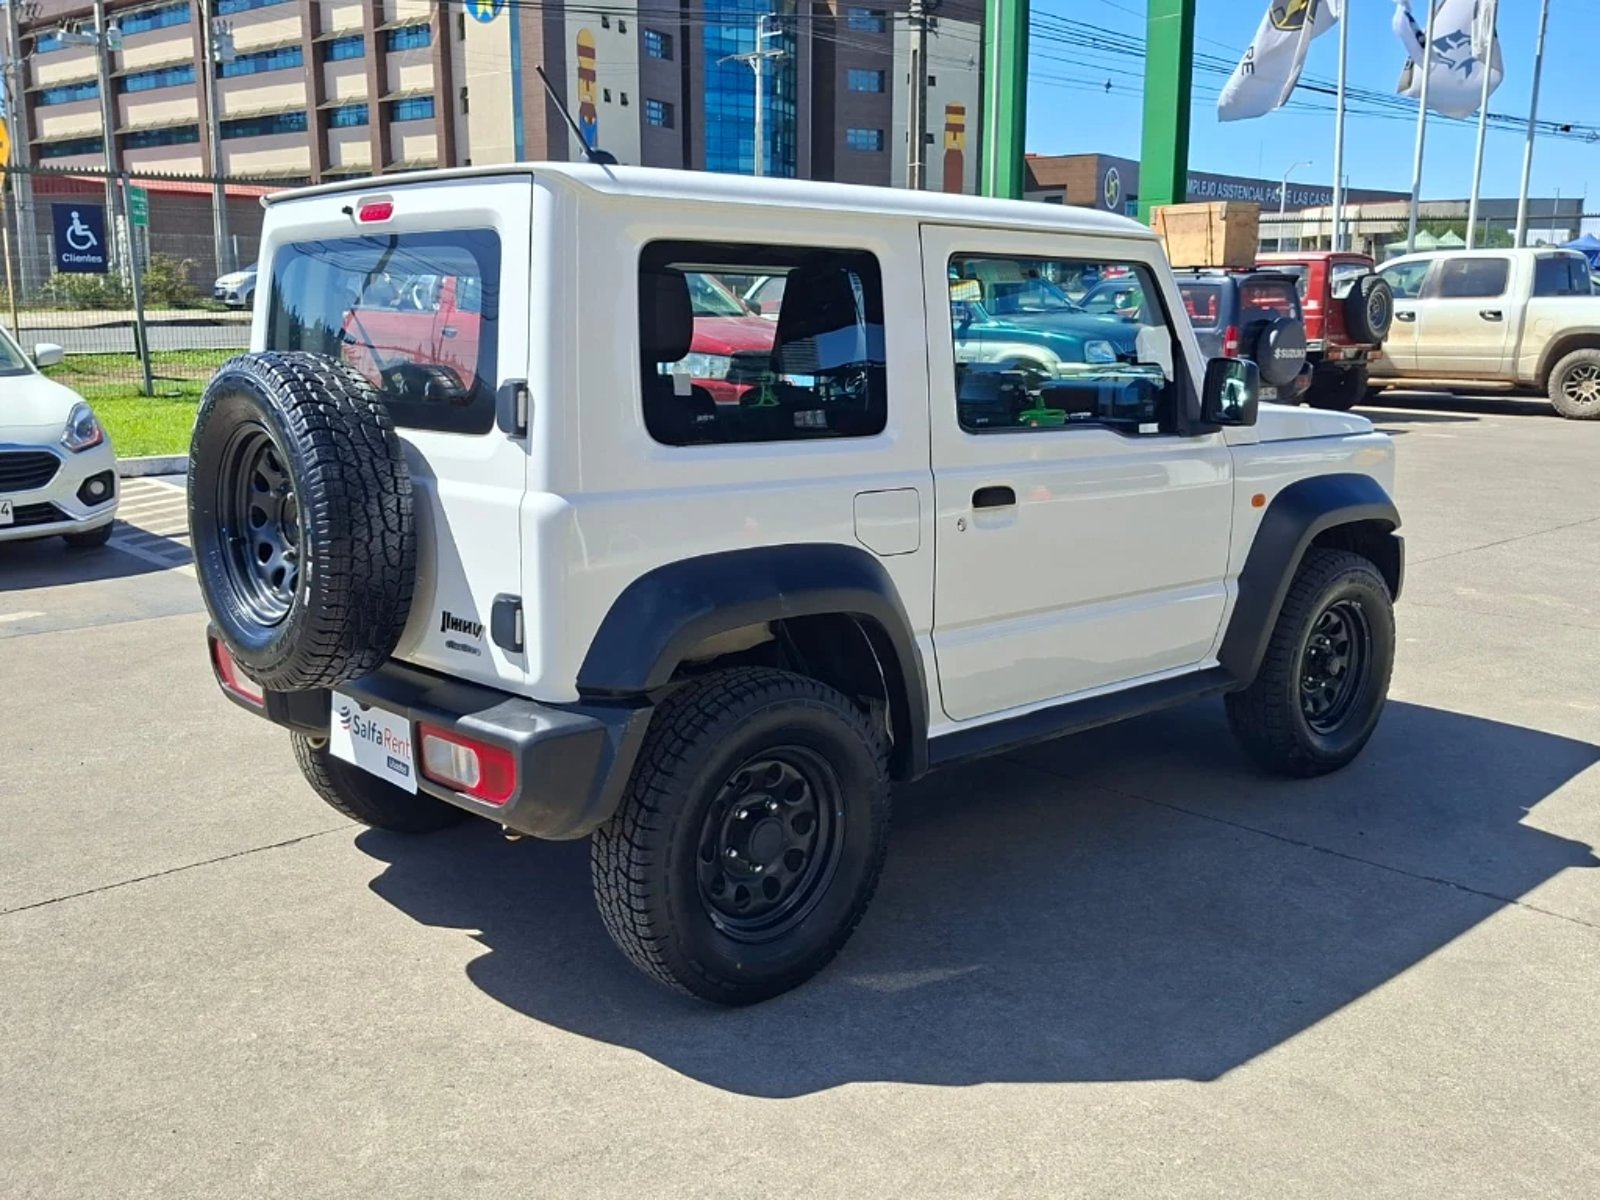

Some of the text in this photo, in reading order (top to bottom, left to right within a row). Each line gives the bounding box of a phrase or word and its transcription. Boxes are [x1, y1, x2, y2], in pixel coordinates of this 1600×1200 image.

[1217, 183, 1265, 202] ASISTENCIAL
[1266, 187, 1292, 204] PAE
[1293, 191, 1309, 205] LAS
[1309, 192, 1334, 206] CASA
[62, 253, 102, 263] Clientes
[353, 714, 410, 759] SalfaRent
